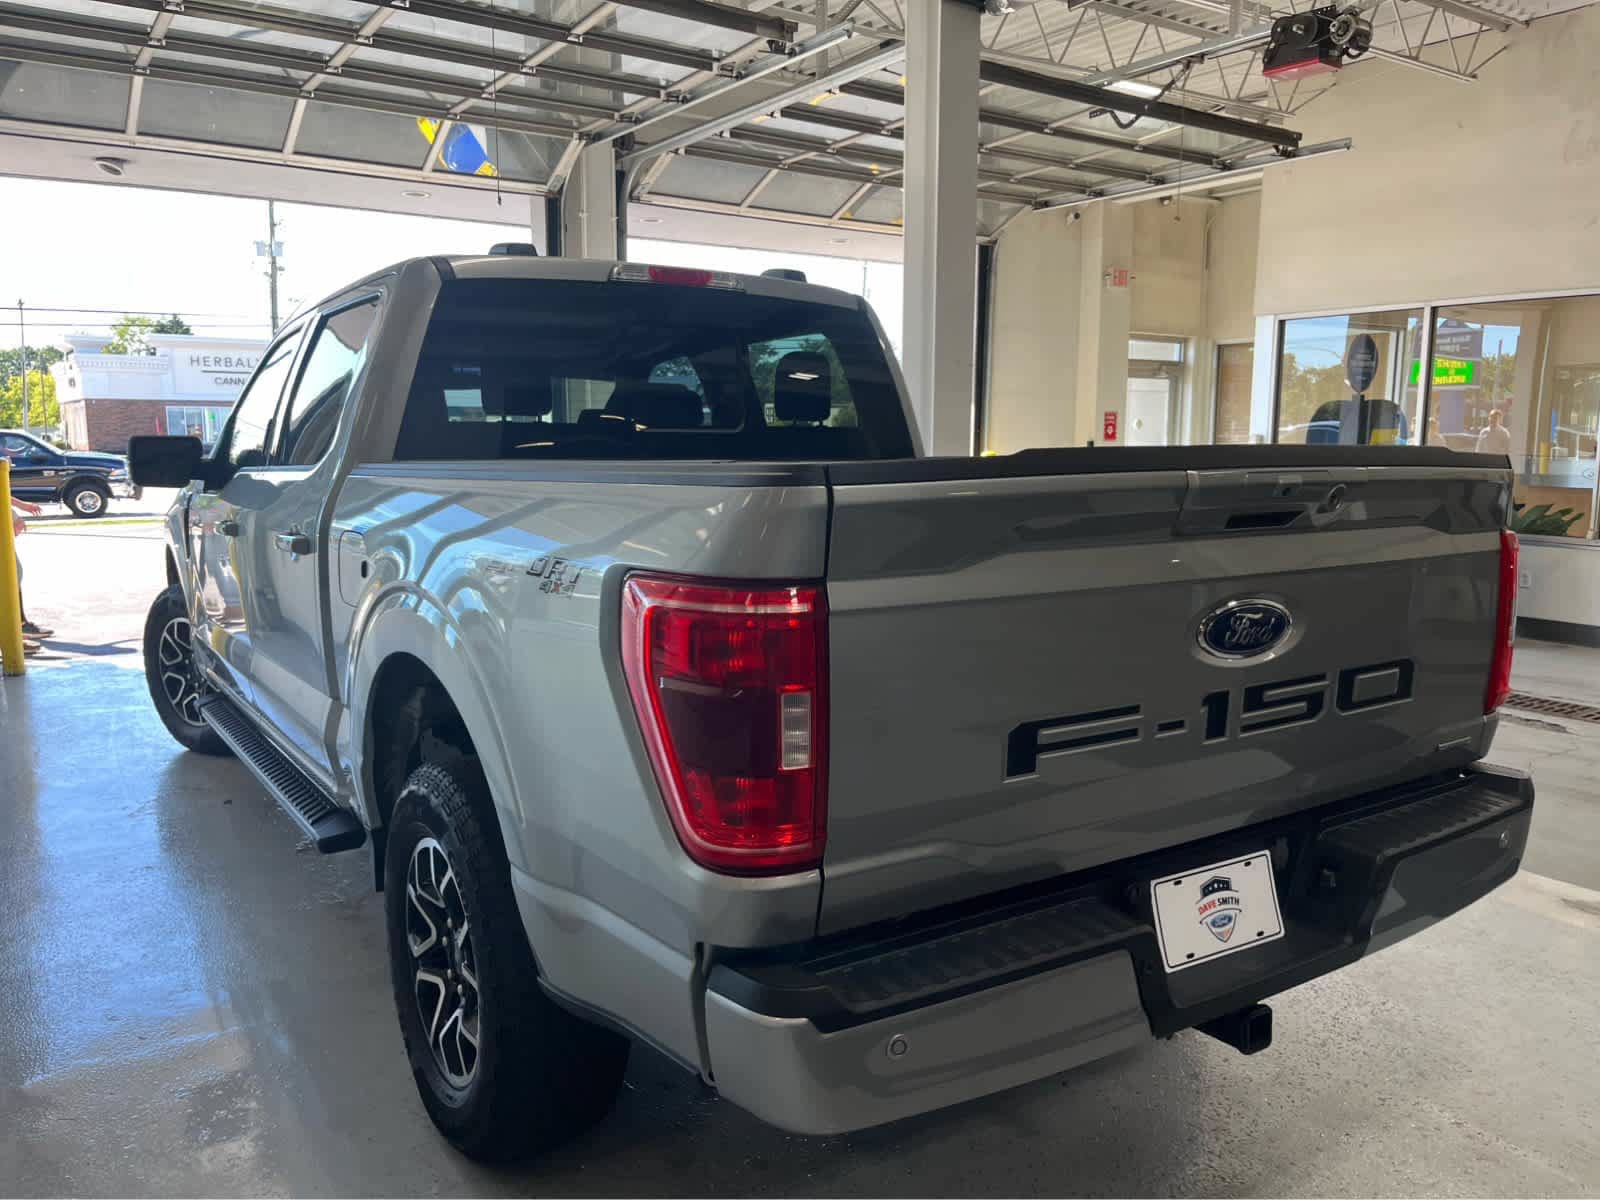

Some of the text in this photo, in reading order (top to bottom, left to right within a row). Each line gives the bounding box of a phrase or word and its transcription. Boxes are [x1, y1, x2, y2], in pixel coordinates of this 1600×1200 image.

[214, 376, 247, 386] CANN
[1224, 611, 1276, 647] Ford
[1003, 657, 1415, 780] F-150
[1199, 896, 1240, 915] DAVE SMITH
